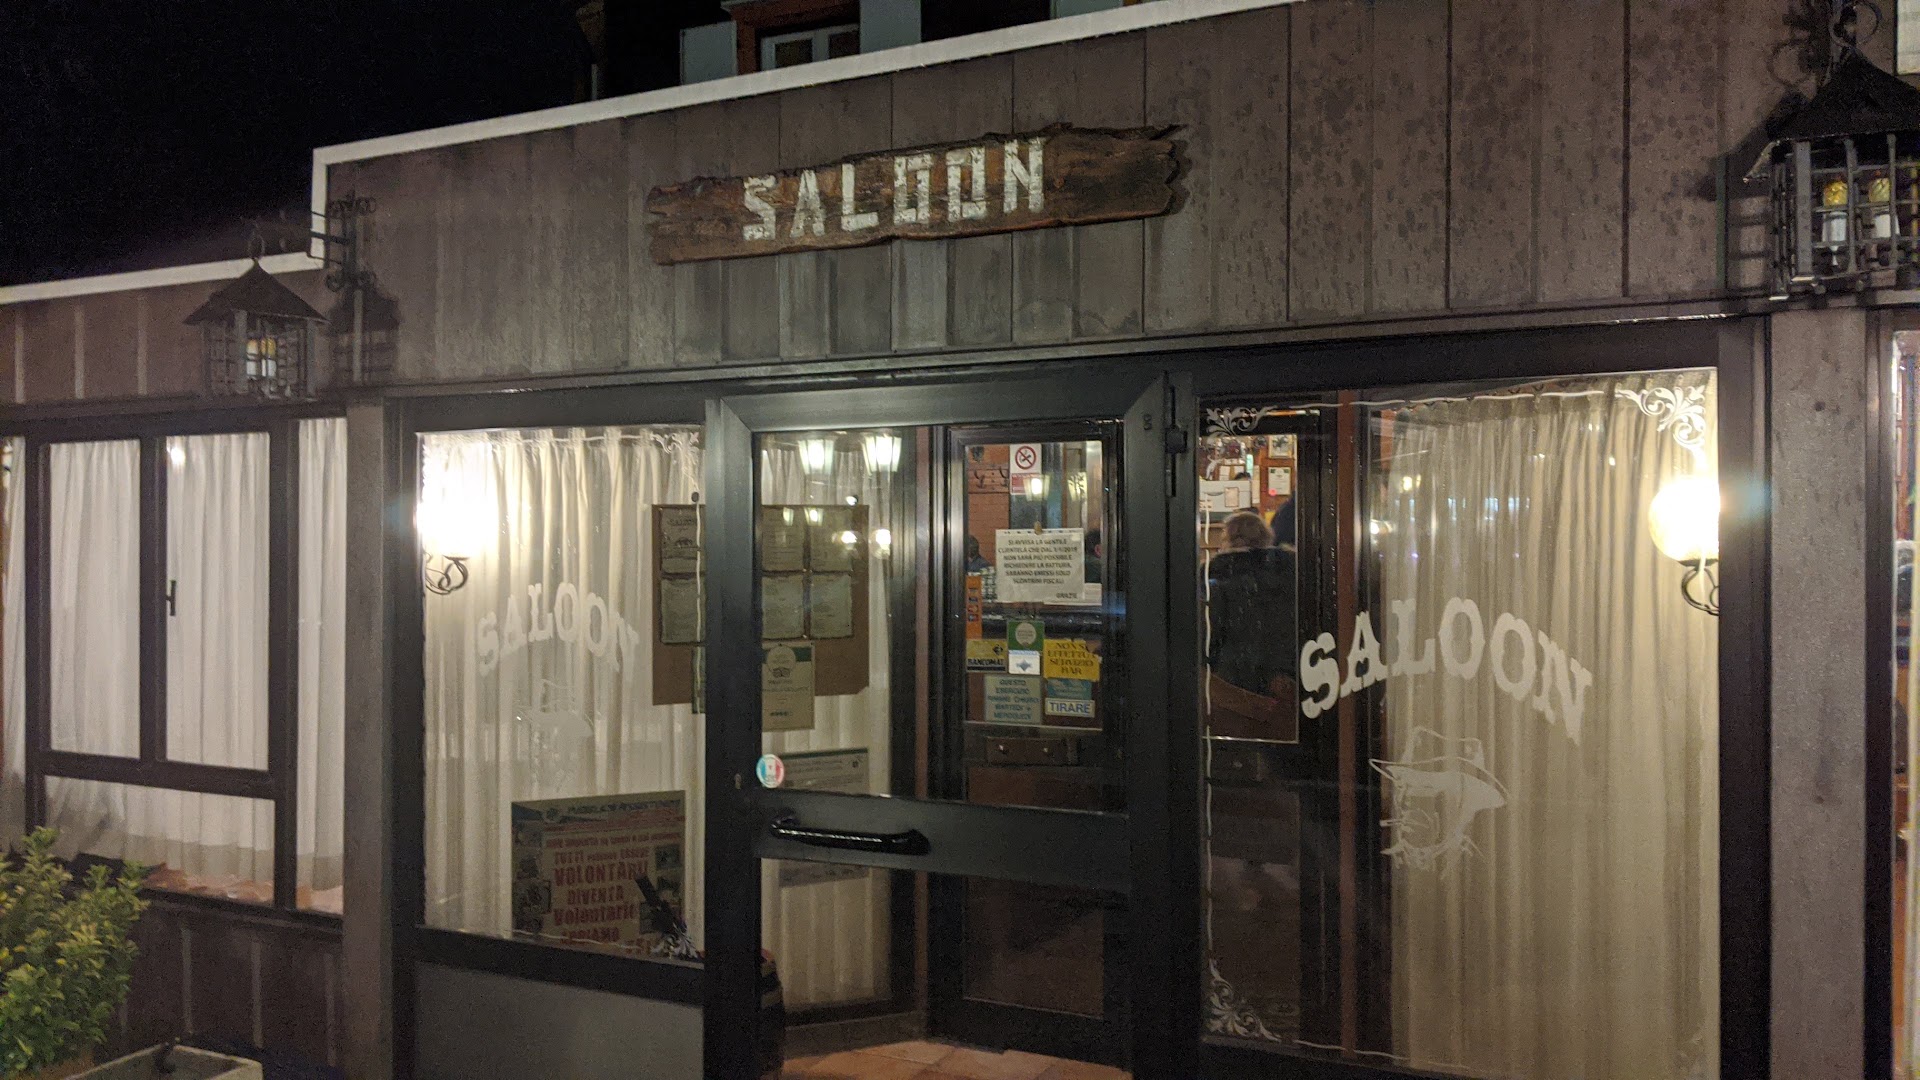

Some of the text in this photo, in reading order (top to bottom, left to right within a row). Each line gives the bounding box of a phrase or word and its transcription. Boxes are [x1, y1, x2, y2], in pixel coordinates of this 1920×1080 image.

[742, 137, 1043, 241] SALOON
[477, 582, 640, 692] SALOON
[1056, 642, 1077, 650] NON
[1050, 658, 1094, 667] SERVIZIO
[1061, 666, 1082, 675] BAR
[1300, 597, 1592, 747] SALOON
[1049, 702, 1091, 714] TIRARE
[554, 850, 584, 865] TUTTI
[566, 884, 624, 906] DIVENTA
